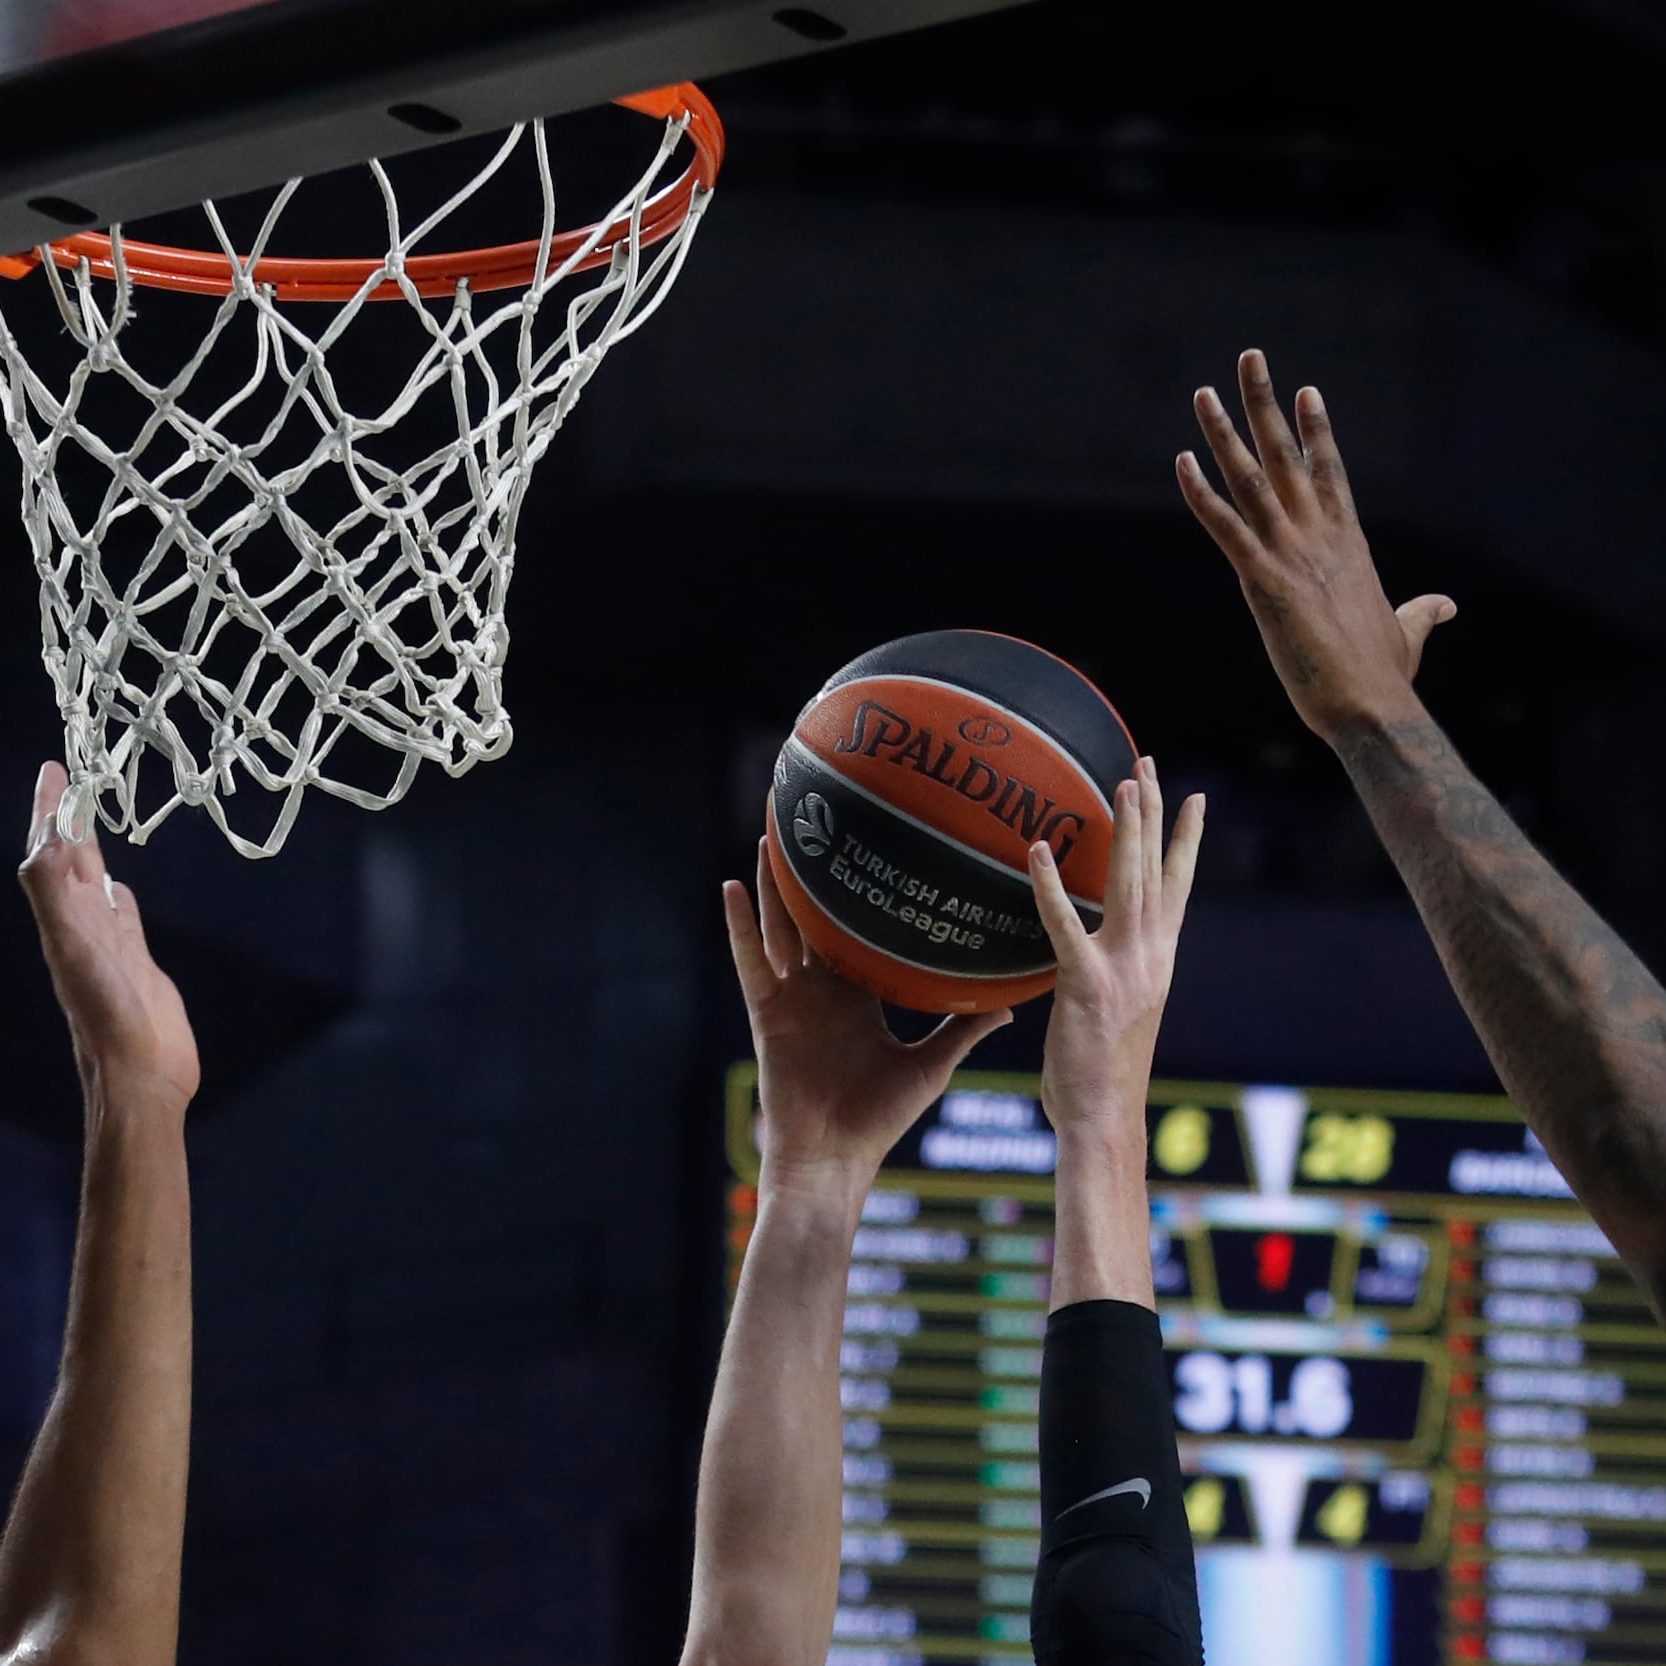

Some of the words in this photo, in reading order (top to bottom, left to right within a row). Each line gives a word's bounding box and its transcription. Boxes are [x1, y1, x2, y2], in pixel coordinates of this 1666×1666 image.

[835, 699, 1086, 866] SPALDING
[829, 855, 987, 951] EuroLeague
[842, 834, 940, 906] TURKISH
